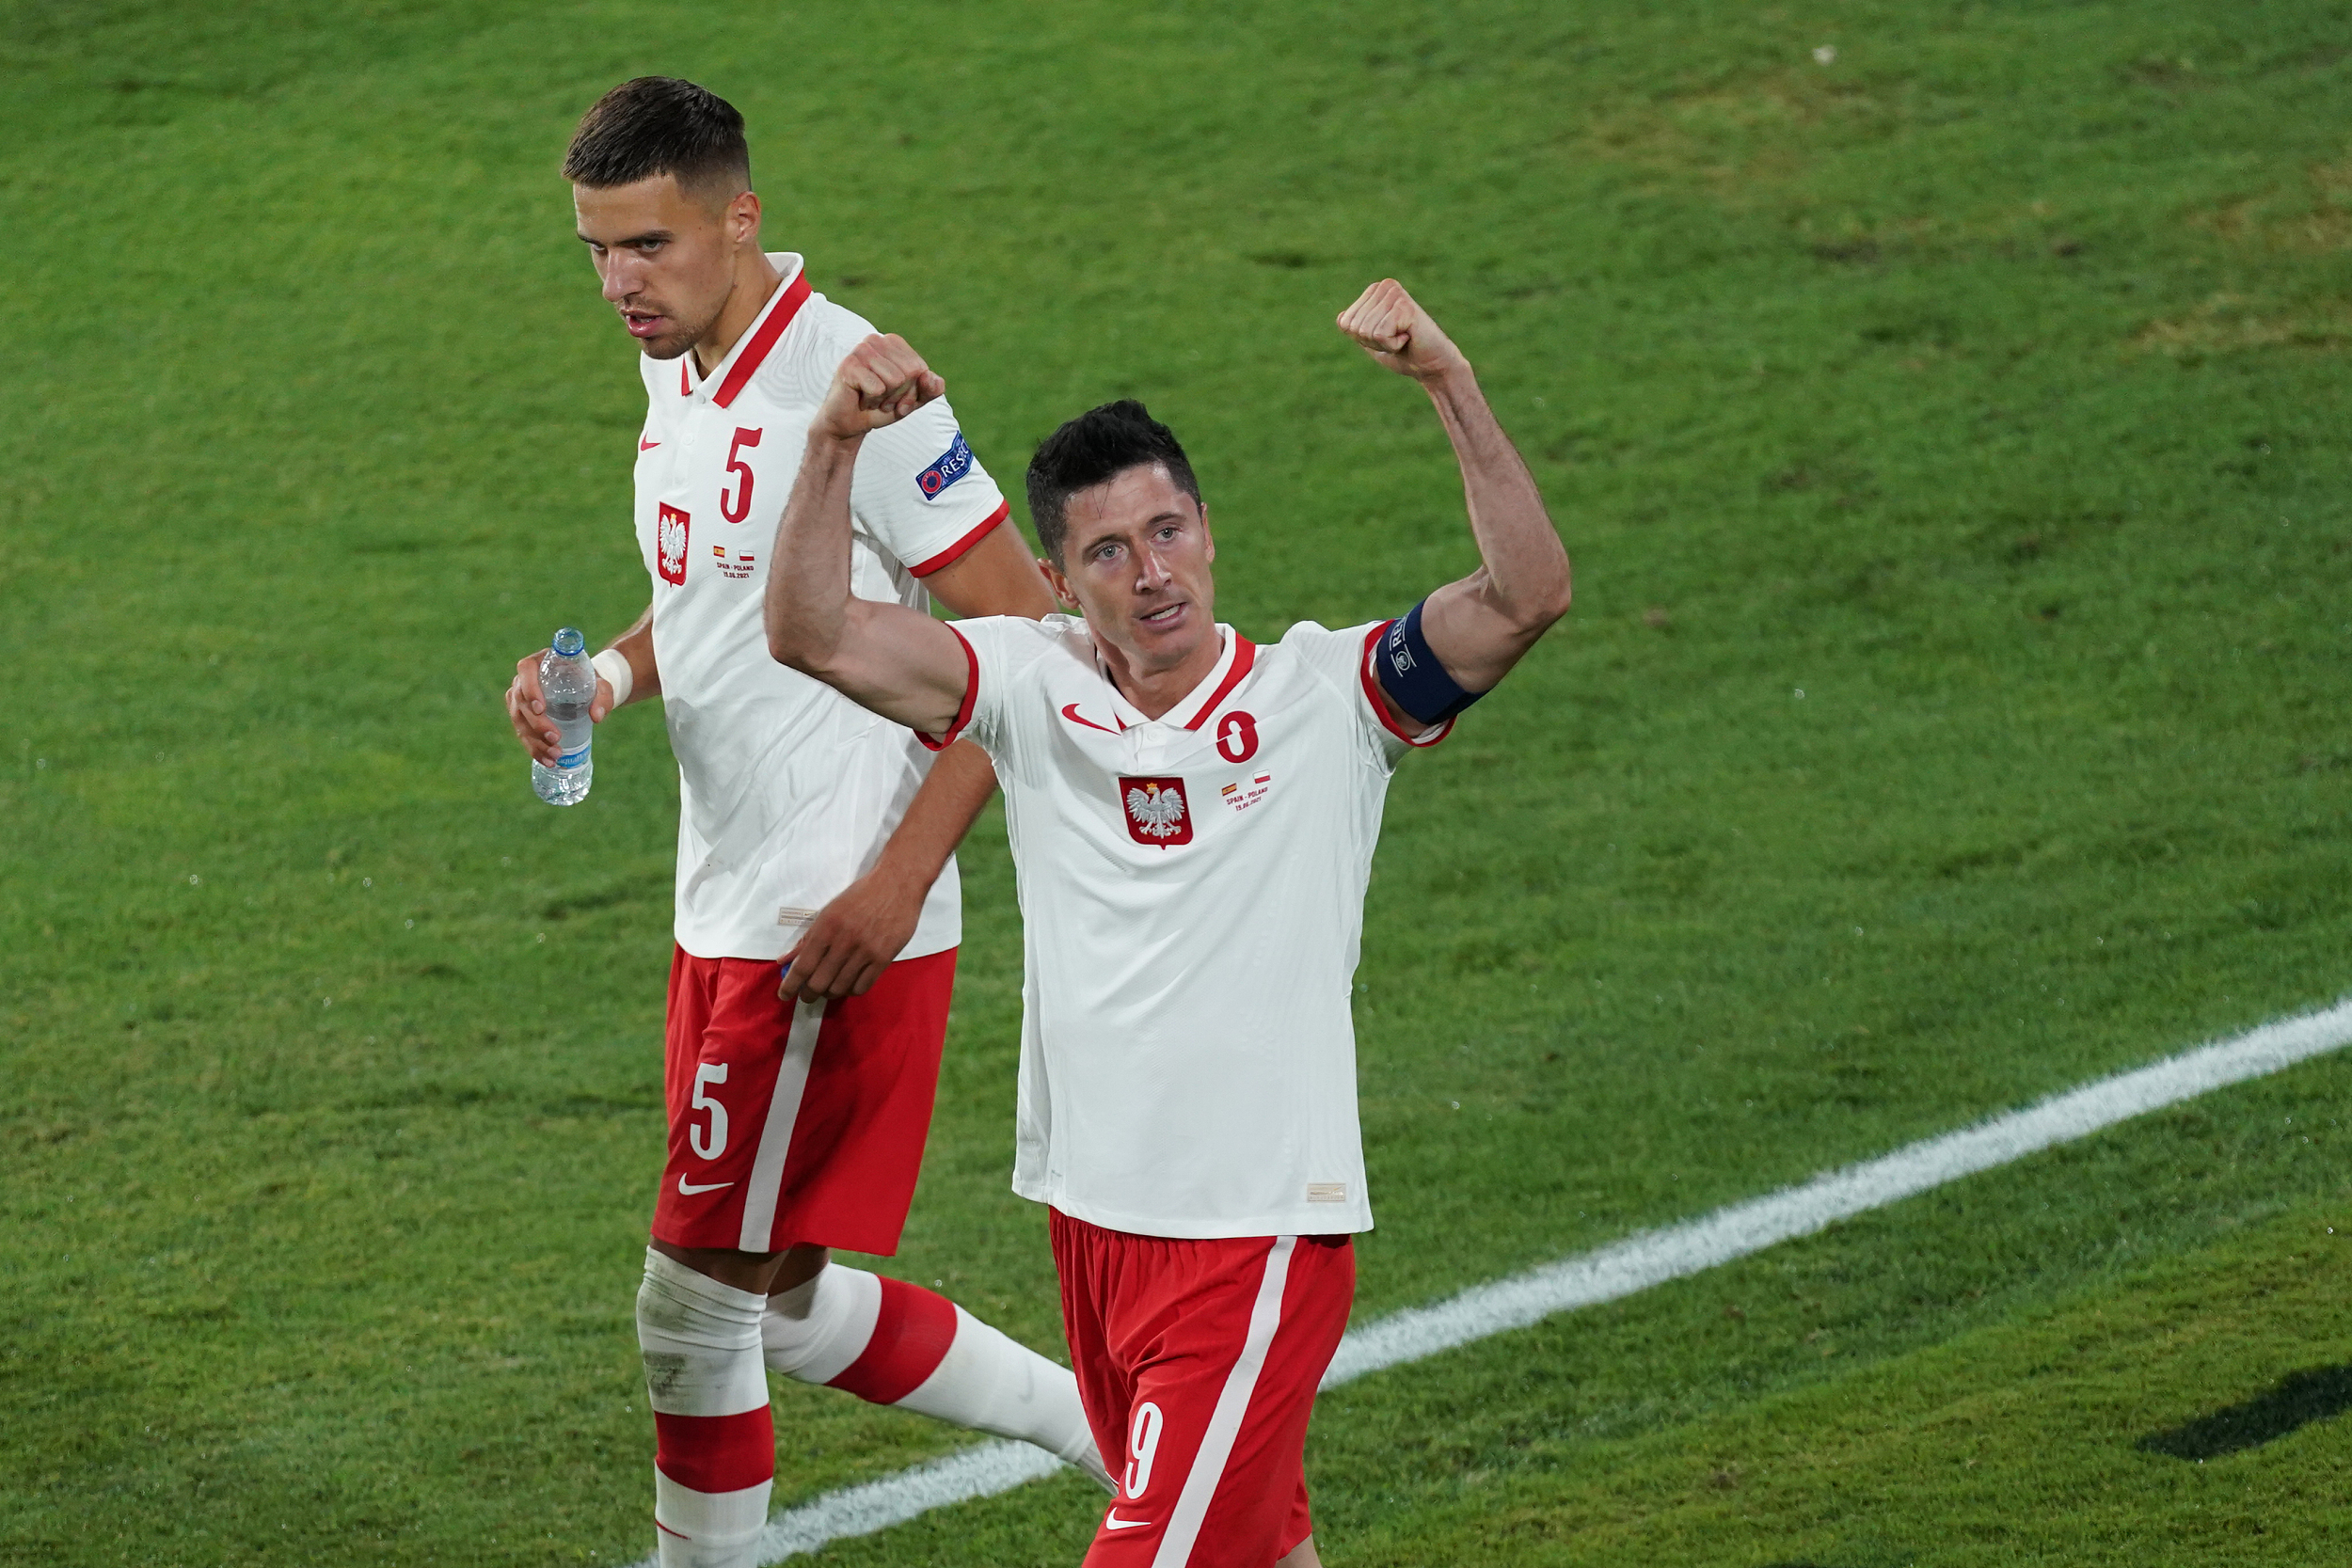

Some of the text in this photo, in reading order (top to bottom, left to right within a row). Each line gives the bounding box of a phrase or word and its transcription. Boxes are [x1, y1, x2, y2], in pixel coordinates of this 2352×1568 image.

[721, 426, 763, 524] 5
[1226, 795, 1244, 805] SPAIN
[1248, 786, 1268, 799] POLAND
[690, 1062, 728, 1161] 5
[1125, 1402, 1164, 1500] 9
